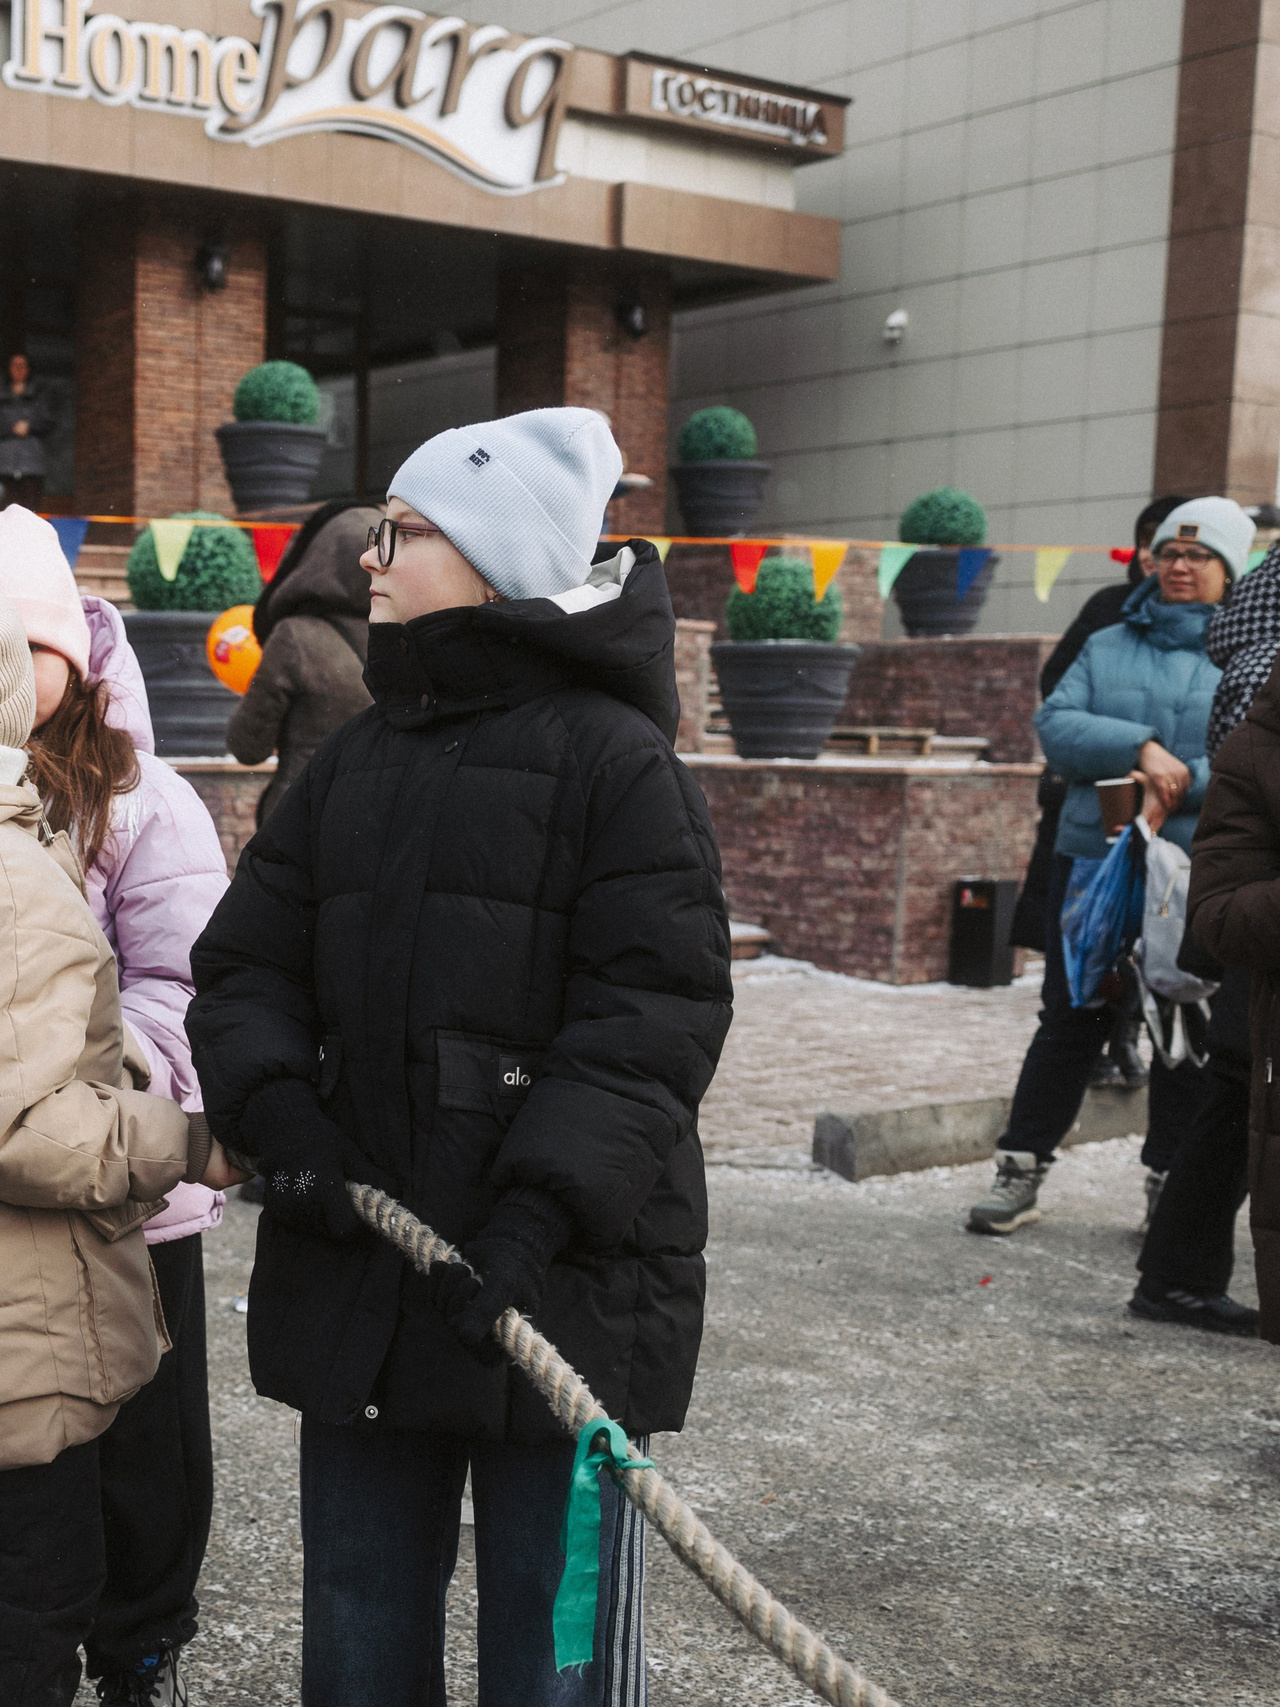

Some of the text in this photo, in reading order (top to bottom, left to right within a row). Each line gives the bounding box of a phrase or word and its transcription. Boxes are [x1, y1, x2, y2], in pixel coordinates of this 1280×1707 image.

[15, 0, 261, 116] Home
[658, 73, 827, 144] ГОСТИНИЦА
[468, 453, 485, 468] BEST
[475, 448, 491, 463] 100%
[503, 1066, 531, 1086] alo
